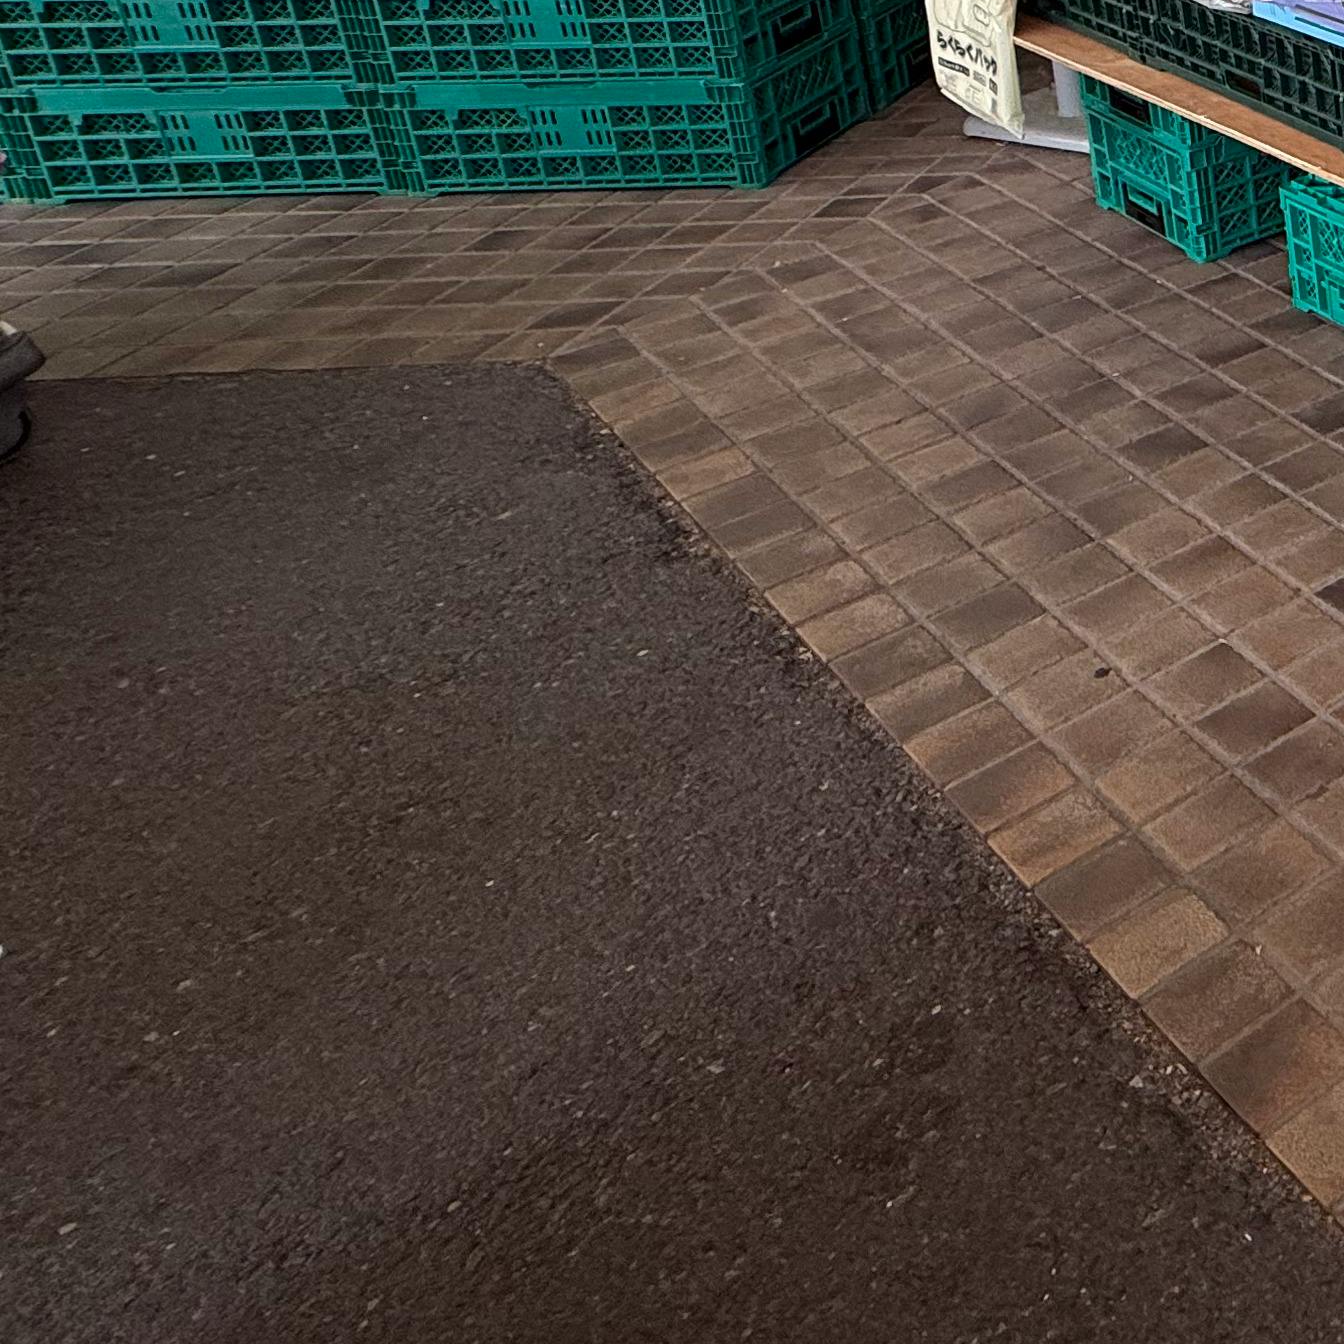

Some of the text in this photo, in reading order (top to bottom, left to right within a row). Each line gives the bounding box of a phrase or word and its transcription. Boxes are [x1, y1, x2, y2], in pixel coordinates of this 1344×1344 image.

[936, 29, 998, 76] らくらくパック
